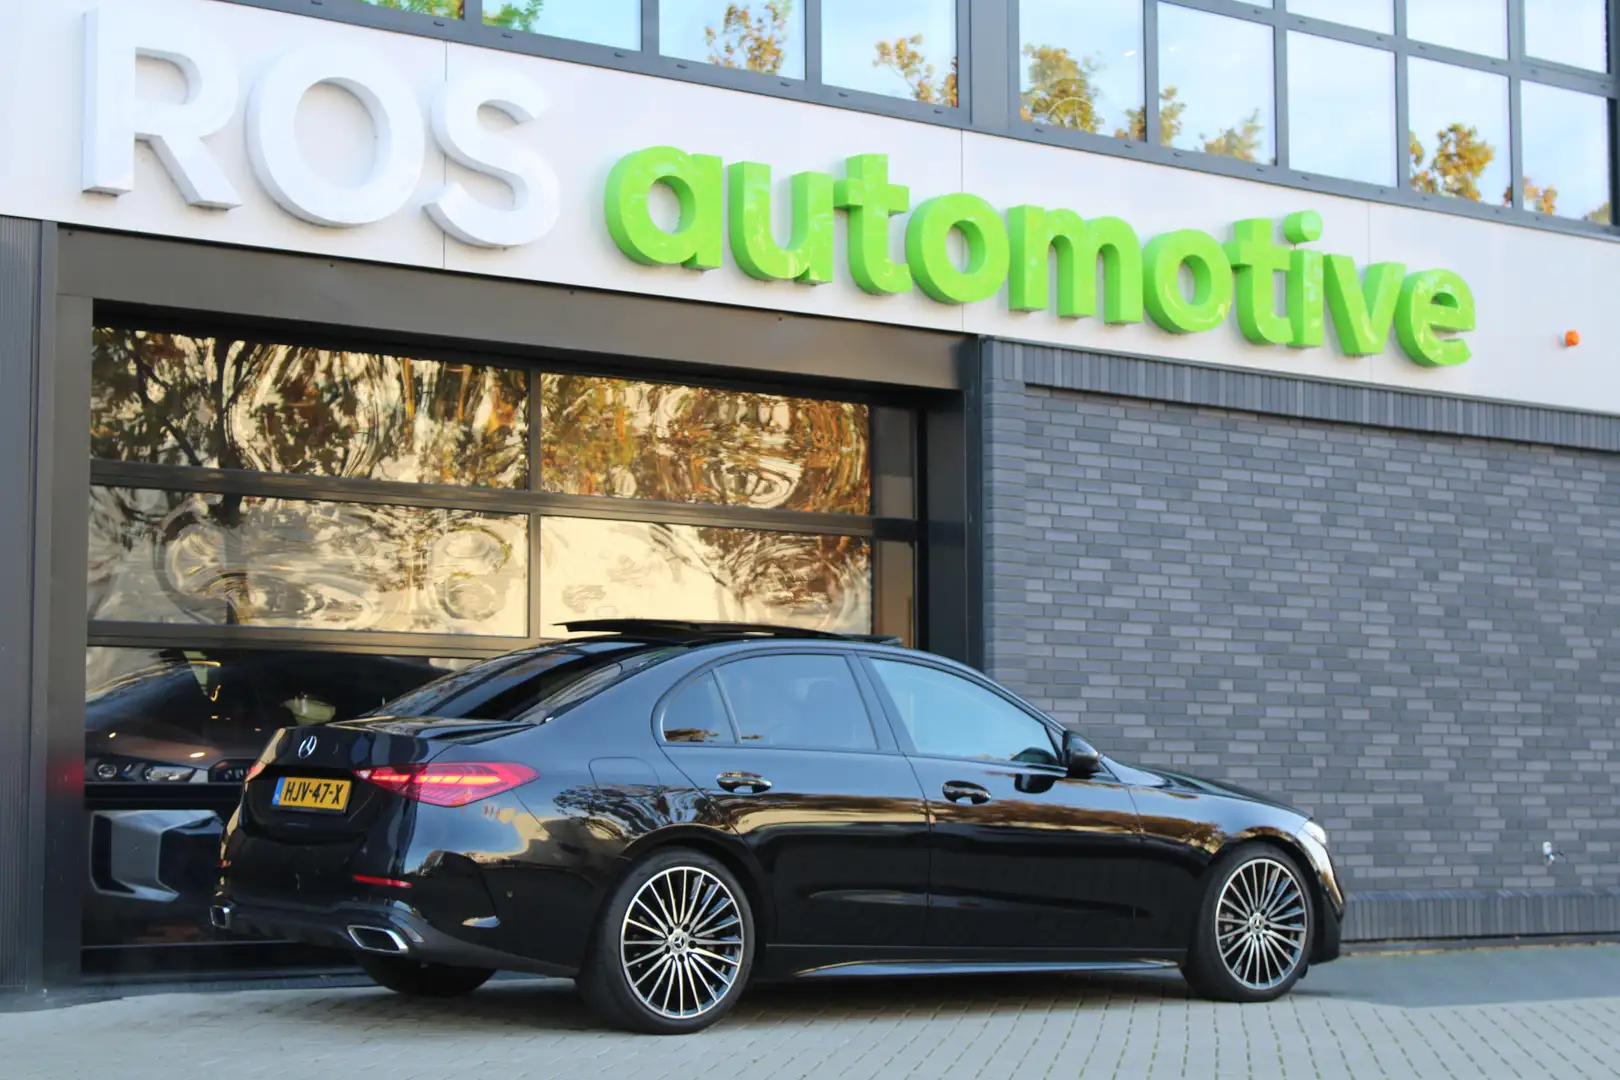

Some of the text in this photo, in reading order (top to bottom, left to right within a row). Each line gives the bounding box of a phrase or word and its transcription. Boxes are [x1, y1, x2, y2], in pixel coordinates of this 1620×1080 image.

[82, 6, 1475, 366] ROS automotive
[283, 780, 344, 805] HJV-47-X
